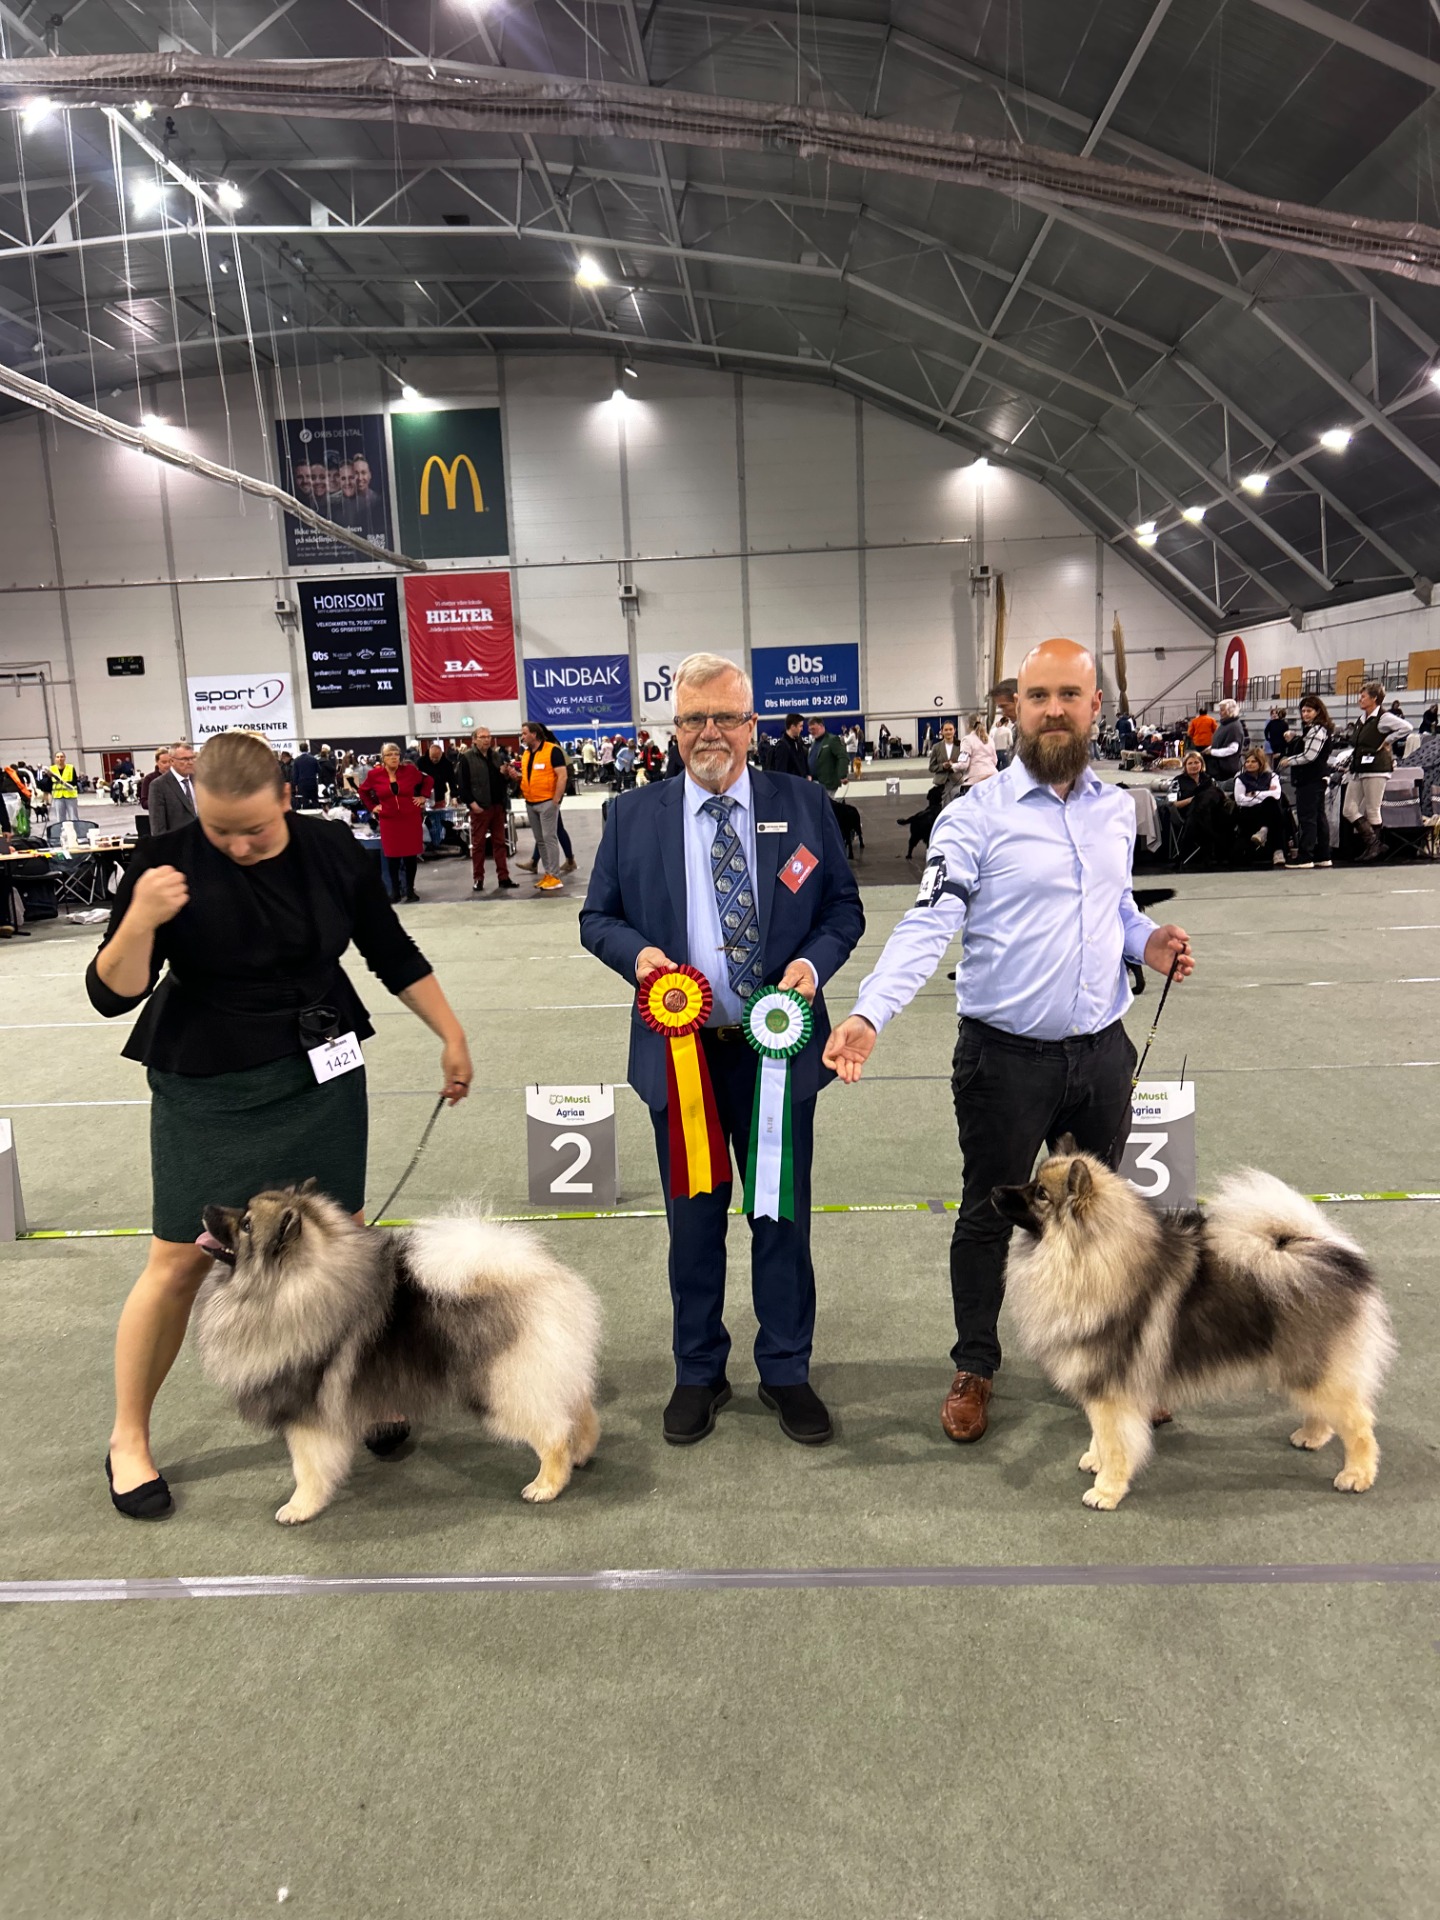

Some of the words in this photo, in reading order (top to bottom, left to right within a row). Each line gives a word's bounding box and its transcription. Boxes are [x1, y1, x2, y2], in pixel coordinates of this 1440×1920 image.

[313, 592, 385, 609] HORISONT
[425, 608, 493, 624] HELTER
[312, 651, 329, 660] Obs
[444, 660, 483, 672] BA
[787, 653, 824, 674] Obs
[532, 666, 621, 688] LINDBAK
[775, 676, 784, 686] Alt
[785, 675, 793, 687] på
[794, 675, 810, 685] lista,
[810, 677, 819, 686] og
[820, 674, 829, 684] litt
[829, 673, 837, 683] til
[377, 680, 393, 690] XXL
[194, 687, 255, 704] sport
[263, 686, 269, 698] 1
[554, 696, 568, 704] WE
[570, 695, 594, 704] MAKE
[595, 695, 603, 703] IT
[765, 698, 778, 708] Obs
[779, 697, 809, 707] Horisont
[812, 695, 832, 705] 09-22
[833, 694, 848, 706] (20)
[933, 695, 944, 706] C
[587, 705, 612, 713] WORK
[889, 784, 897, 794] 4
[325, 1048, 357, 1072] 1421
[564, 1095, 591, 1104] Musti
[1138, 1092, 1168, 1101] Musti
[556, 1108, 578, 1118] Agria
[1131, 1105, 1153, 1116] Agria
[550, 1132, 593, 1193] 2
[1125, 1132, 1170, 1197] 3
